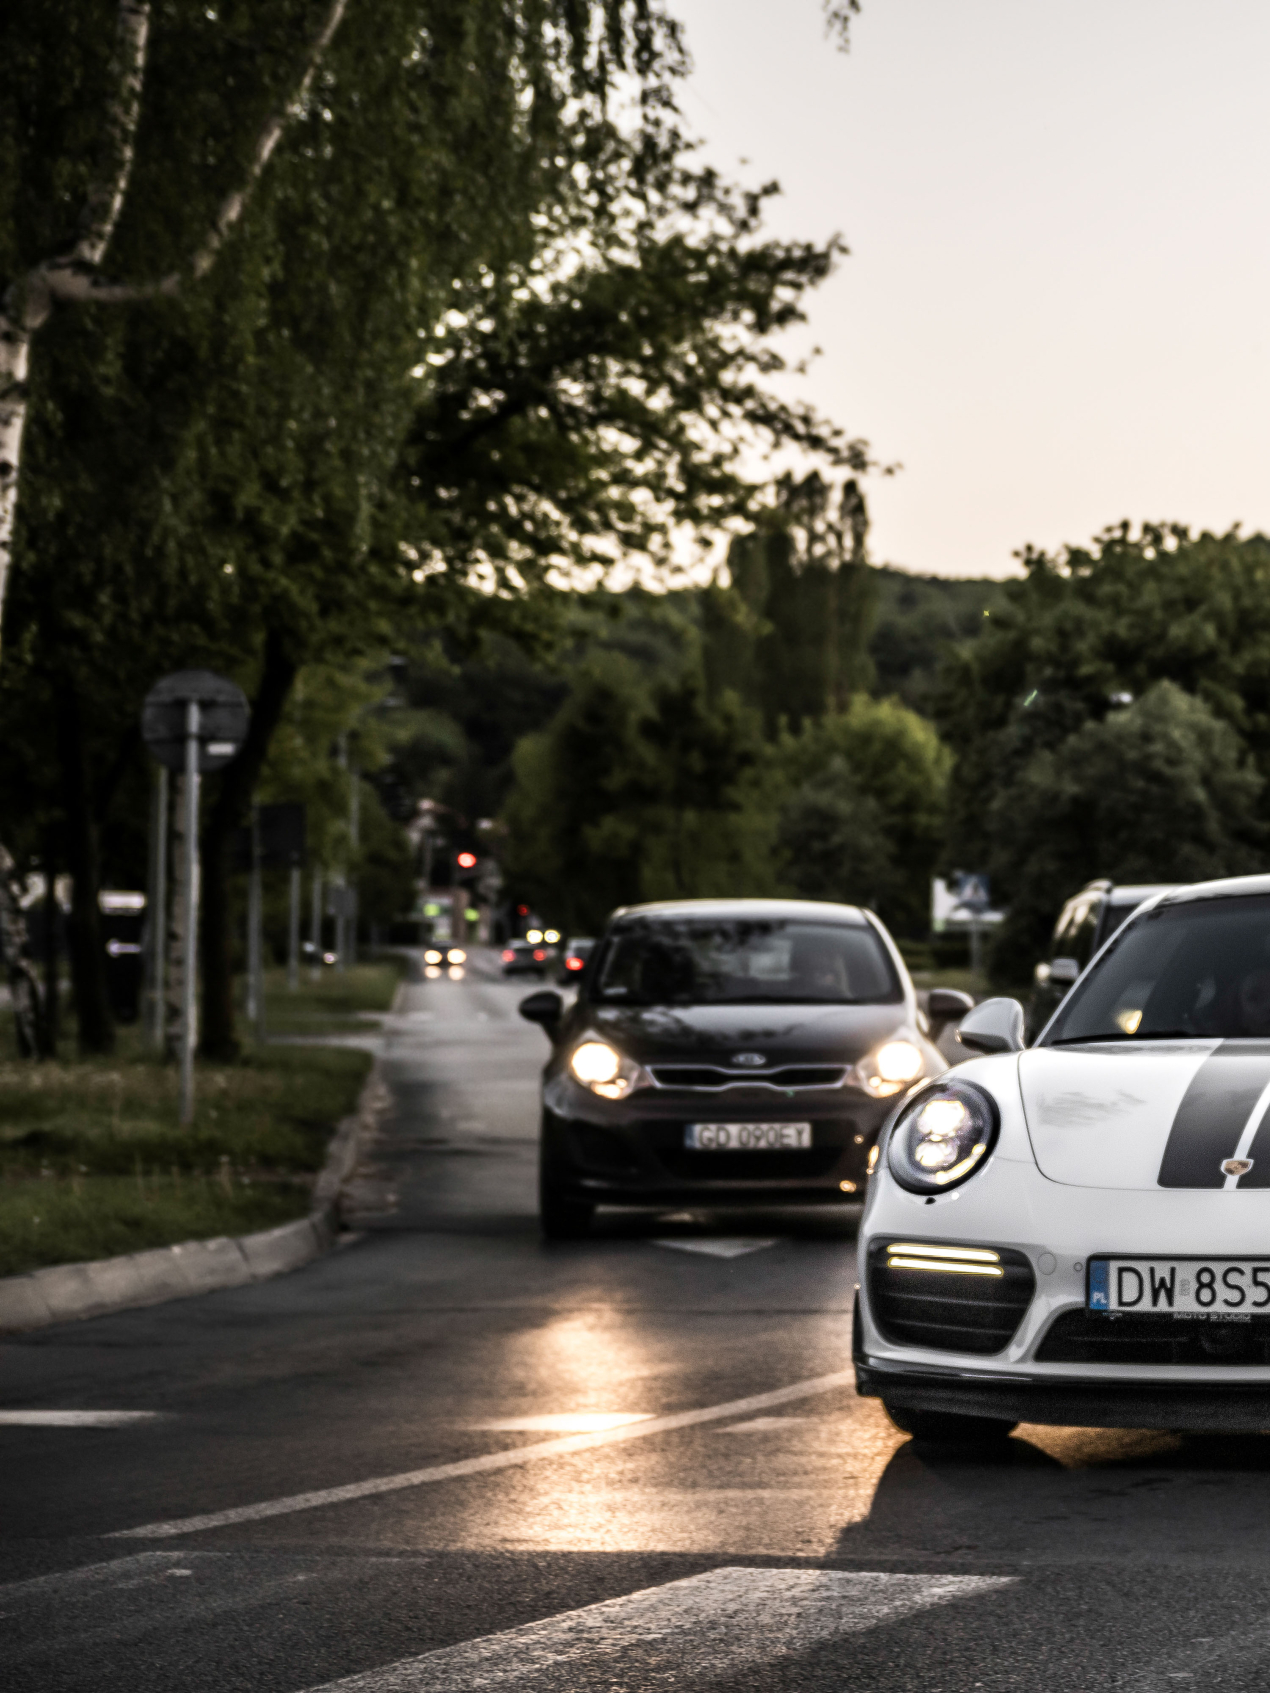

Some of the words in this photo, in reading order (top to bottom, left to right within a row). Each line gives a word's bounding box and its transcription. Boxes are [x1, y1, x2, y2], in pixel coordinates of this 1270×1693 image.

[701, 1126, 731, 1147] GD
[1117, 1266, 1176, 1307] DW
[1093, 1292, 1107, 1303] PL
